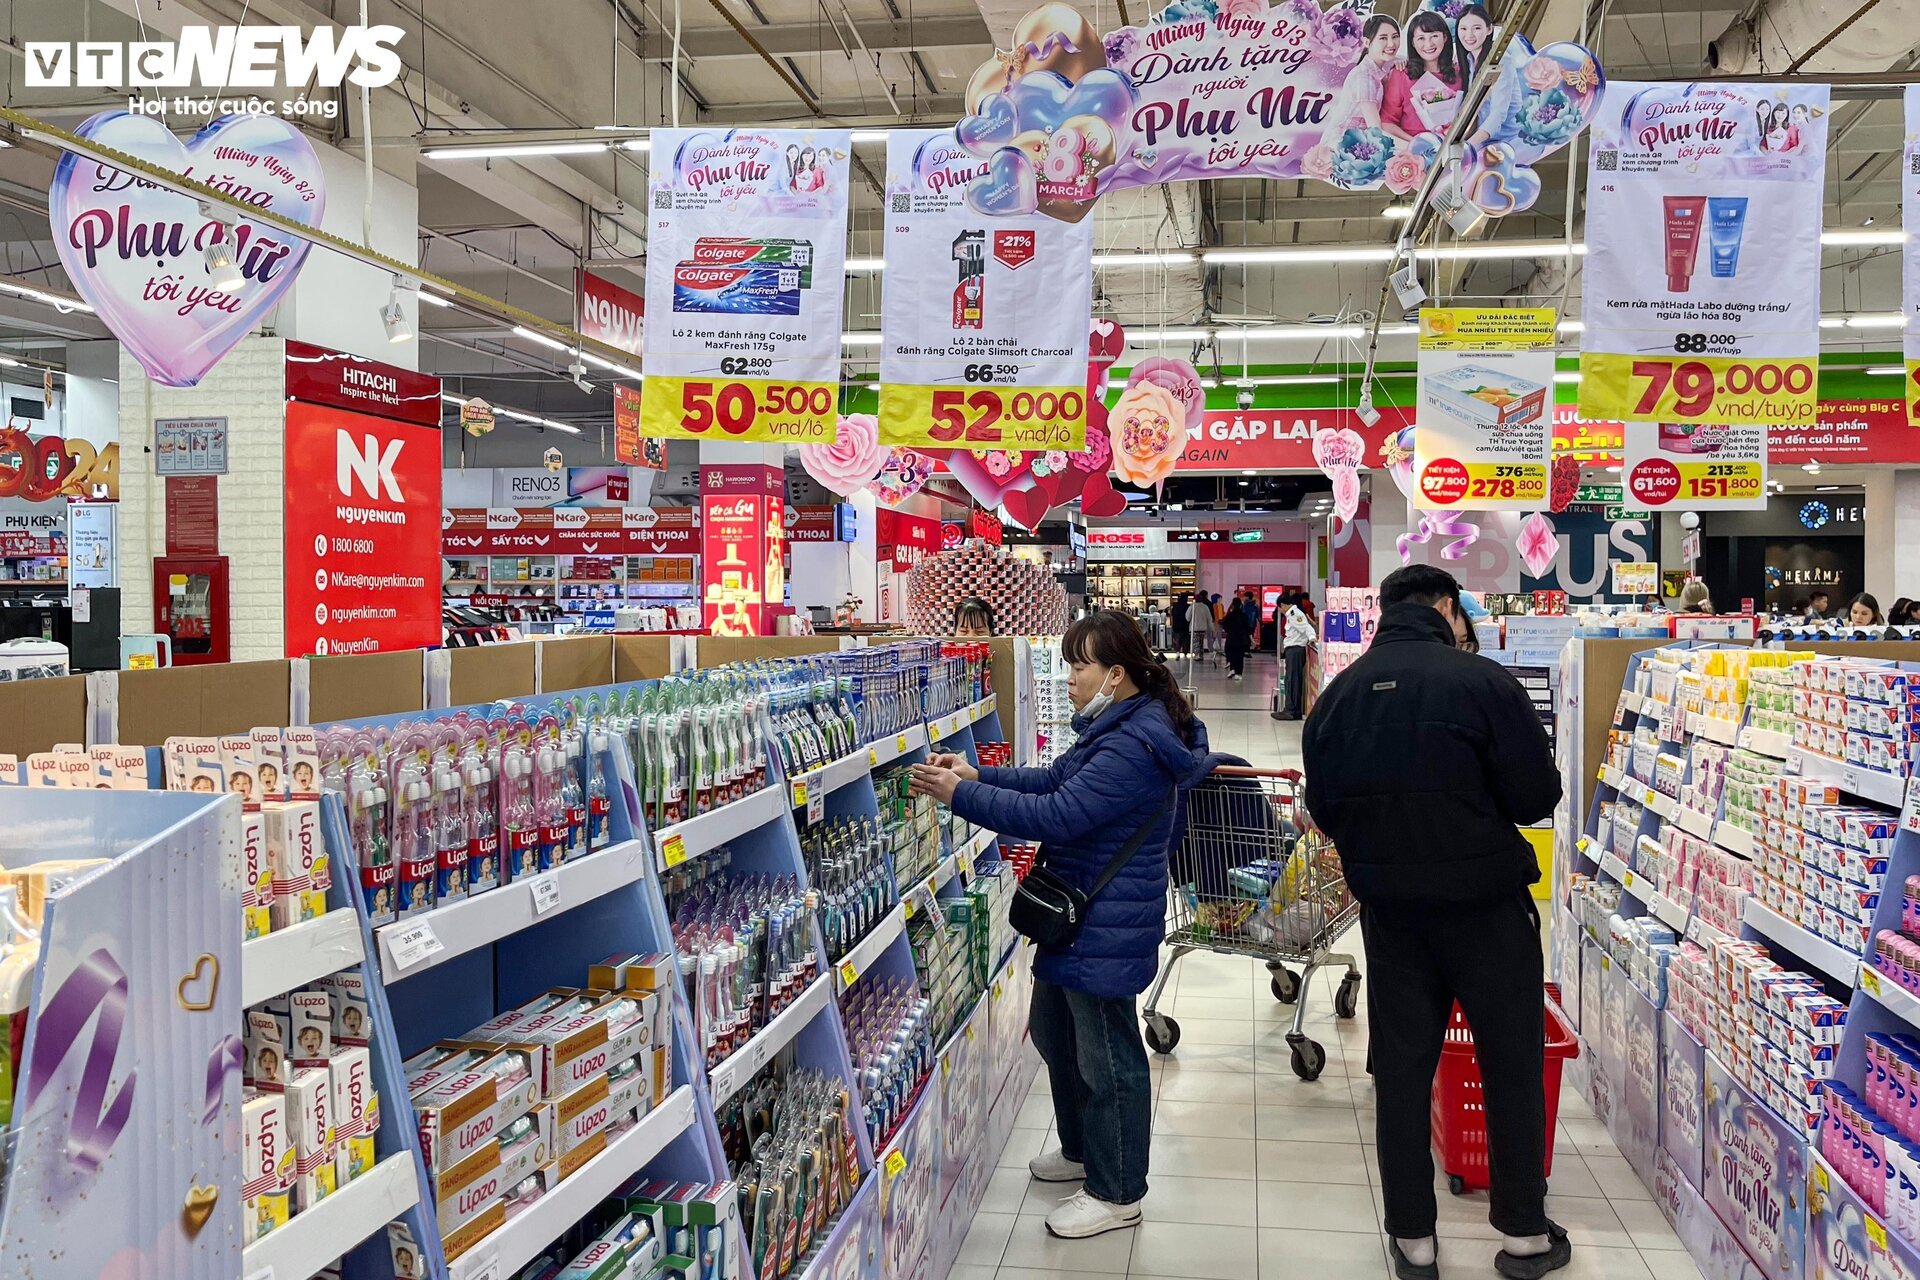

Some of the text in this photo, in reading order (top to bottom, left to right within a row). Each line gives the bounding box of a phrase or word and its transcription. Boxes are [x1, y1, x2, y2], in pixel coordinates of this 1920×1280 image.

[1146, 12, 1308, 51] Mừng Ngày 8/3
[1130, 39, 1312, 88] Dành tặng
[1192, 75, 1249, 100] người
[1132, 84, 1334, 148] Phụ Nữ
[1645, 99, 1727, 121] Dành tặng
[1638, 116, 1738, 152] Phụ Nữ
[1208, 142, 1291, 169] tôi yêu
[687, 160, 771, 192] Phụ Nữ
[927, 166, 972, 194] Phụ
[1039, 184, 1085, 197] MARCH
[1600, 185, 1615, 193] 416
[658, 221, 670, 229] 517
[68, 204, 190, 270] Phụ
[998, 235, 1032, 248] -21%
[696, 247, 746, 260] Colgate
[677, 268, 734, 283] Colgate
[742, 286, 779, 296] MaxFresh
[1607, 300, 1629, 309] Kem
[1631, 299, 1648, 309] rửa
[1698, 301, 1722, 311] Labo
[1724, 300, 1755, 313] dưỡng
[1656, 311, 1742, 322] ngừa lão hóa 80g
[672, 329, 685, 338] Lô
[695, 330, 715, 338] kem
[717, 329, 742, 339] đánh
[744, 330, 766, 341] răng
[768, 332, 807, 342] Colgate
[953, 337, 1018, 347] Lô 2 bàn chải
[705, 342, 776, 352] MaxFresh 175g
[896, 346, 1074, 357] đánh răng Colgate Slimsoft Charcoal
[343, 367, 397, 393] HITACHI
[340, 384, 400, 406] Inspire the Next
[1631, 361, 1814, 418] 79.000
[680, 382, 833, 436] 50.500
[927, 389, 1084, 442] 52.000
[1716, 398, 1814, 421] vnd/tuýp
[1815, 402, 1900, 414] gày cùng Big C
[769, 417, 824, 436] vnd/lô
[1208, 415, 1268, 446] GẶP
[1476, 423, 1500, 432] Thùng
[1529, 423, 1544, 433] hộp
[1813, 420, 1834, 431] sản
[1836, 418, 1869, 432] phẩm
[1014, 423, 1071, 444] vnd/lô
[1526, 430, 1544, 439] uống
[1518, 438, 1544, 447] Yogurt
[1521, 452, 1544, 460] 180ml
[336, 428, 406, 504] NK
[512, 477, 561, 493] RENO3
[1423, 476, 1468, 490] 97.800
[1471, 478, 1543, 498] 278.800
[1633, 477, 1677, 491] 61.600
[1688, 478, 1760, 497] 151.800
[5, 515, 58, 530] PHỤ KIỆN
[488, 514, 519, 524] NKare
[555, 513, 587, 523] NKare
[624, 513, 656, 523] NKare
[447, 535, 467, 547] TÓC
[491, 533, 534, 546] SẤY TÓC
[558, 529, 622, 539] CHĂM SÓC SỨC KHỎE
[629, 529, 690, 541] ĐIỆN THOẠI
[801, 529, 830, 540] THOẠI
[331, 537, 374, 554] 1800 6800
[331, 571, 425, 591] NKare@nguyenkim.com
[331, 606, 397, 622] nguyenkim.com
[251, 731, 279, 745] Lipzo
[286, 730, 313, 745] Lipzo
[185, 741, 216, 756] Lipzo
[221, 739, 251, 753] Lipzo
[114, 754, 145, 769] Lipzo
[245, 824, 259, 886] Lipzo
[572, 1051, 606, 1081] Lipzo
[257, 1107, 278, 1176] Lipzo
[458, 1178, 498, 1215] Lipzo
[1721, 1154, 1752, 1219] Phụ
[1753, 1180, 1781, 1236] Nữ
